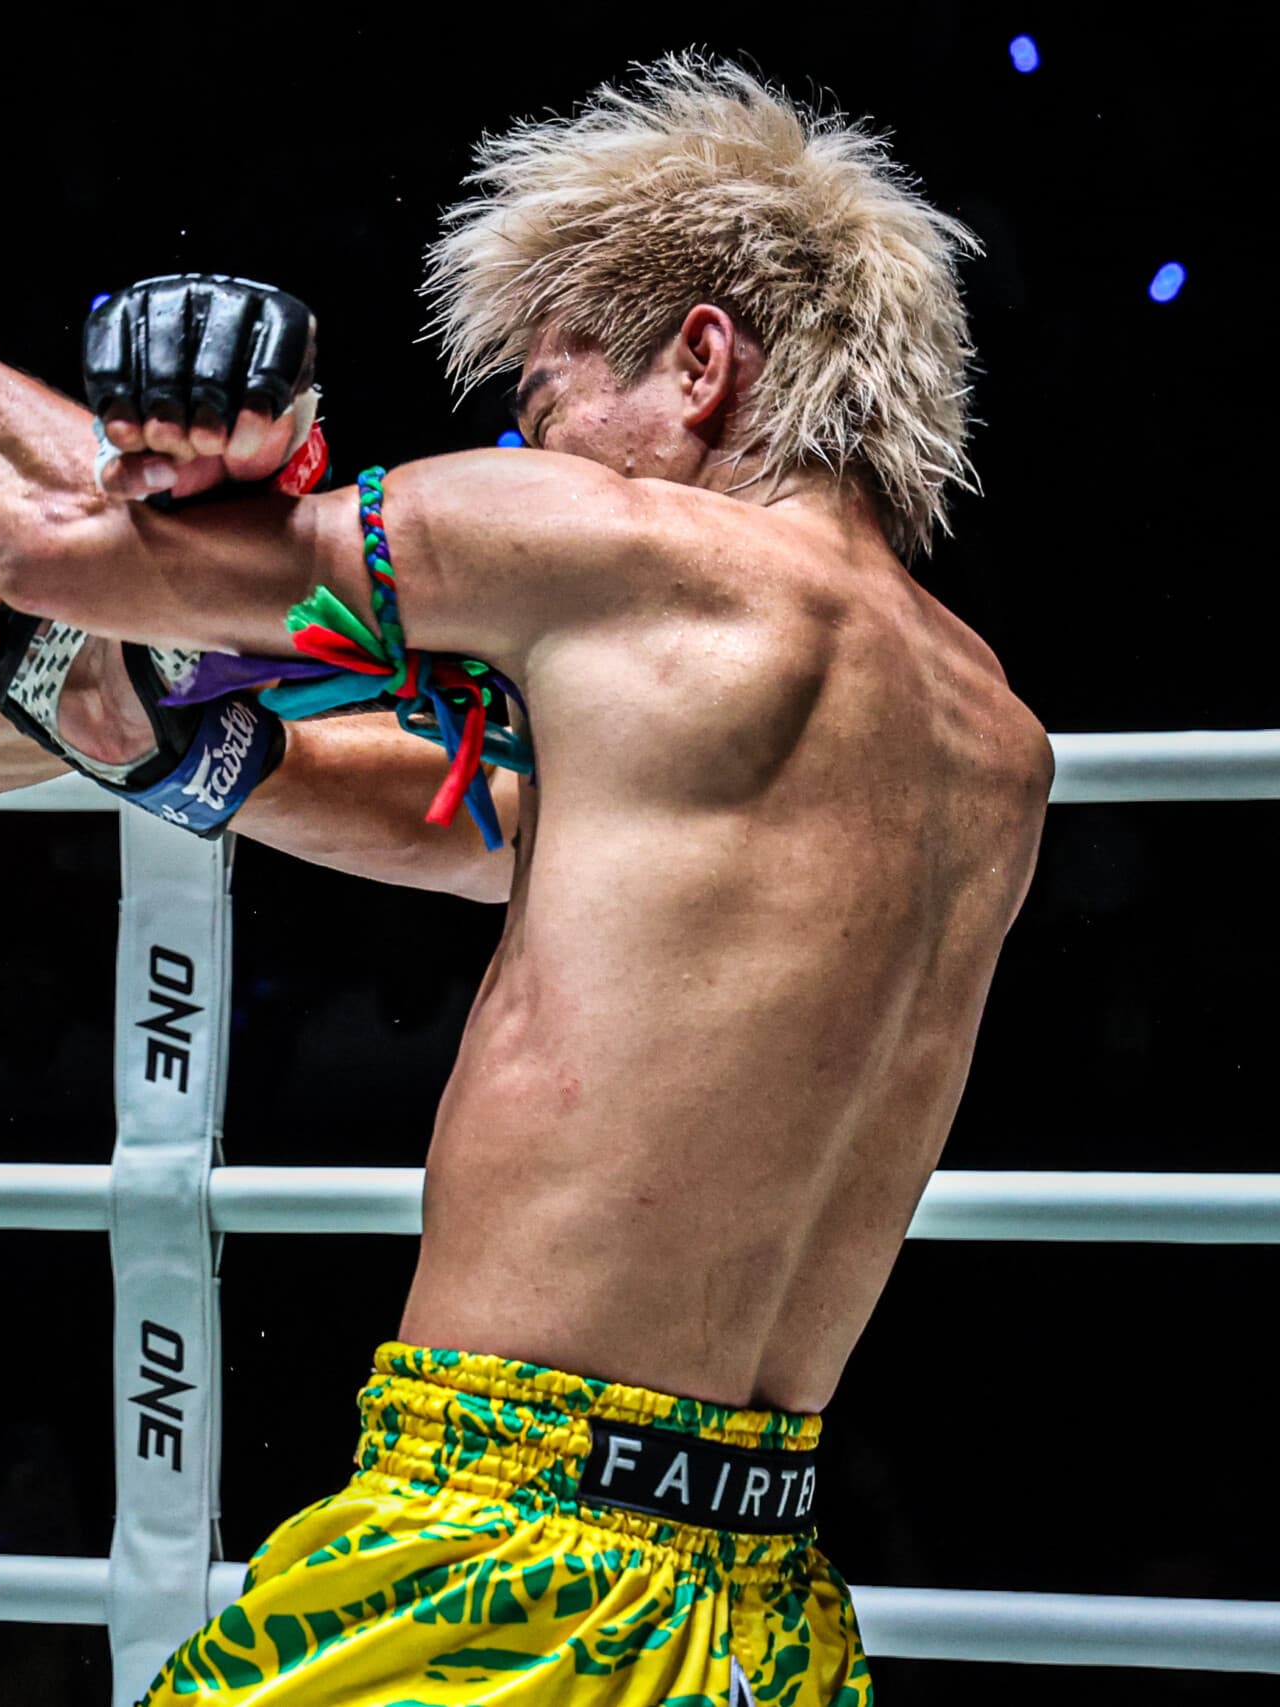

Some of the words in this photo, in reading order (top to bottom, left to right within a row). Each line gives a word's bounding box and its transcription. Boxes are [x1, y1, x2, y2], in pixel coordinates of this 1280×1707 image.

[134, 944, 205, 1094] ONE
[128, 1320, 197, 1473] ONE
[600, 1436, 816, 1518] FAIRTE
